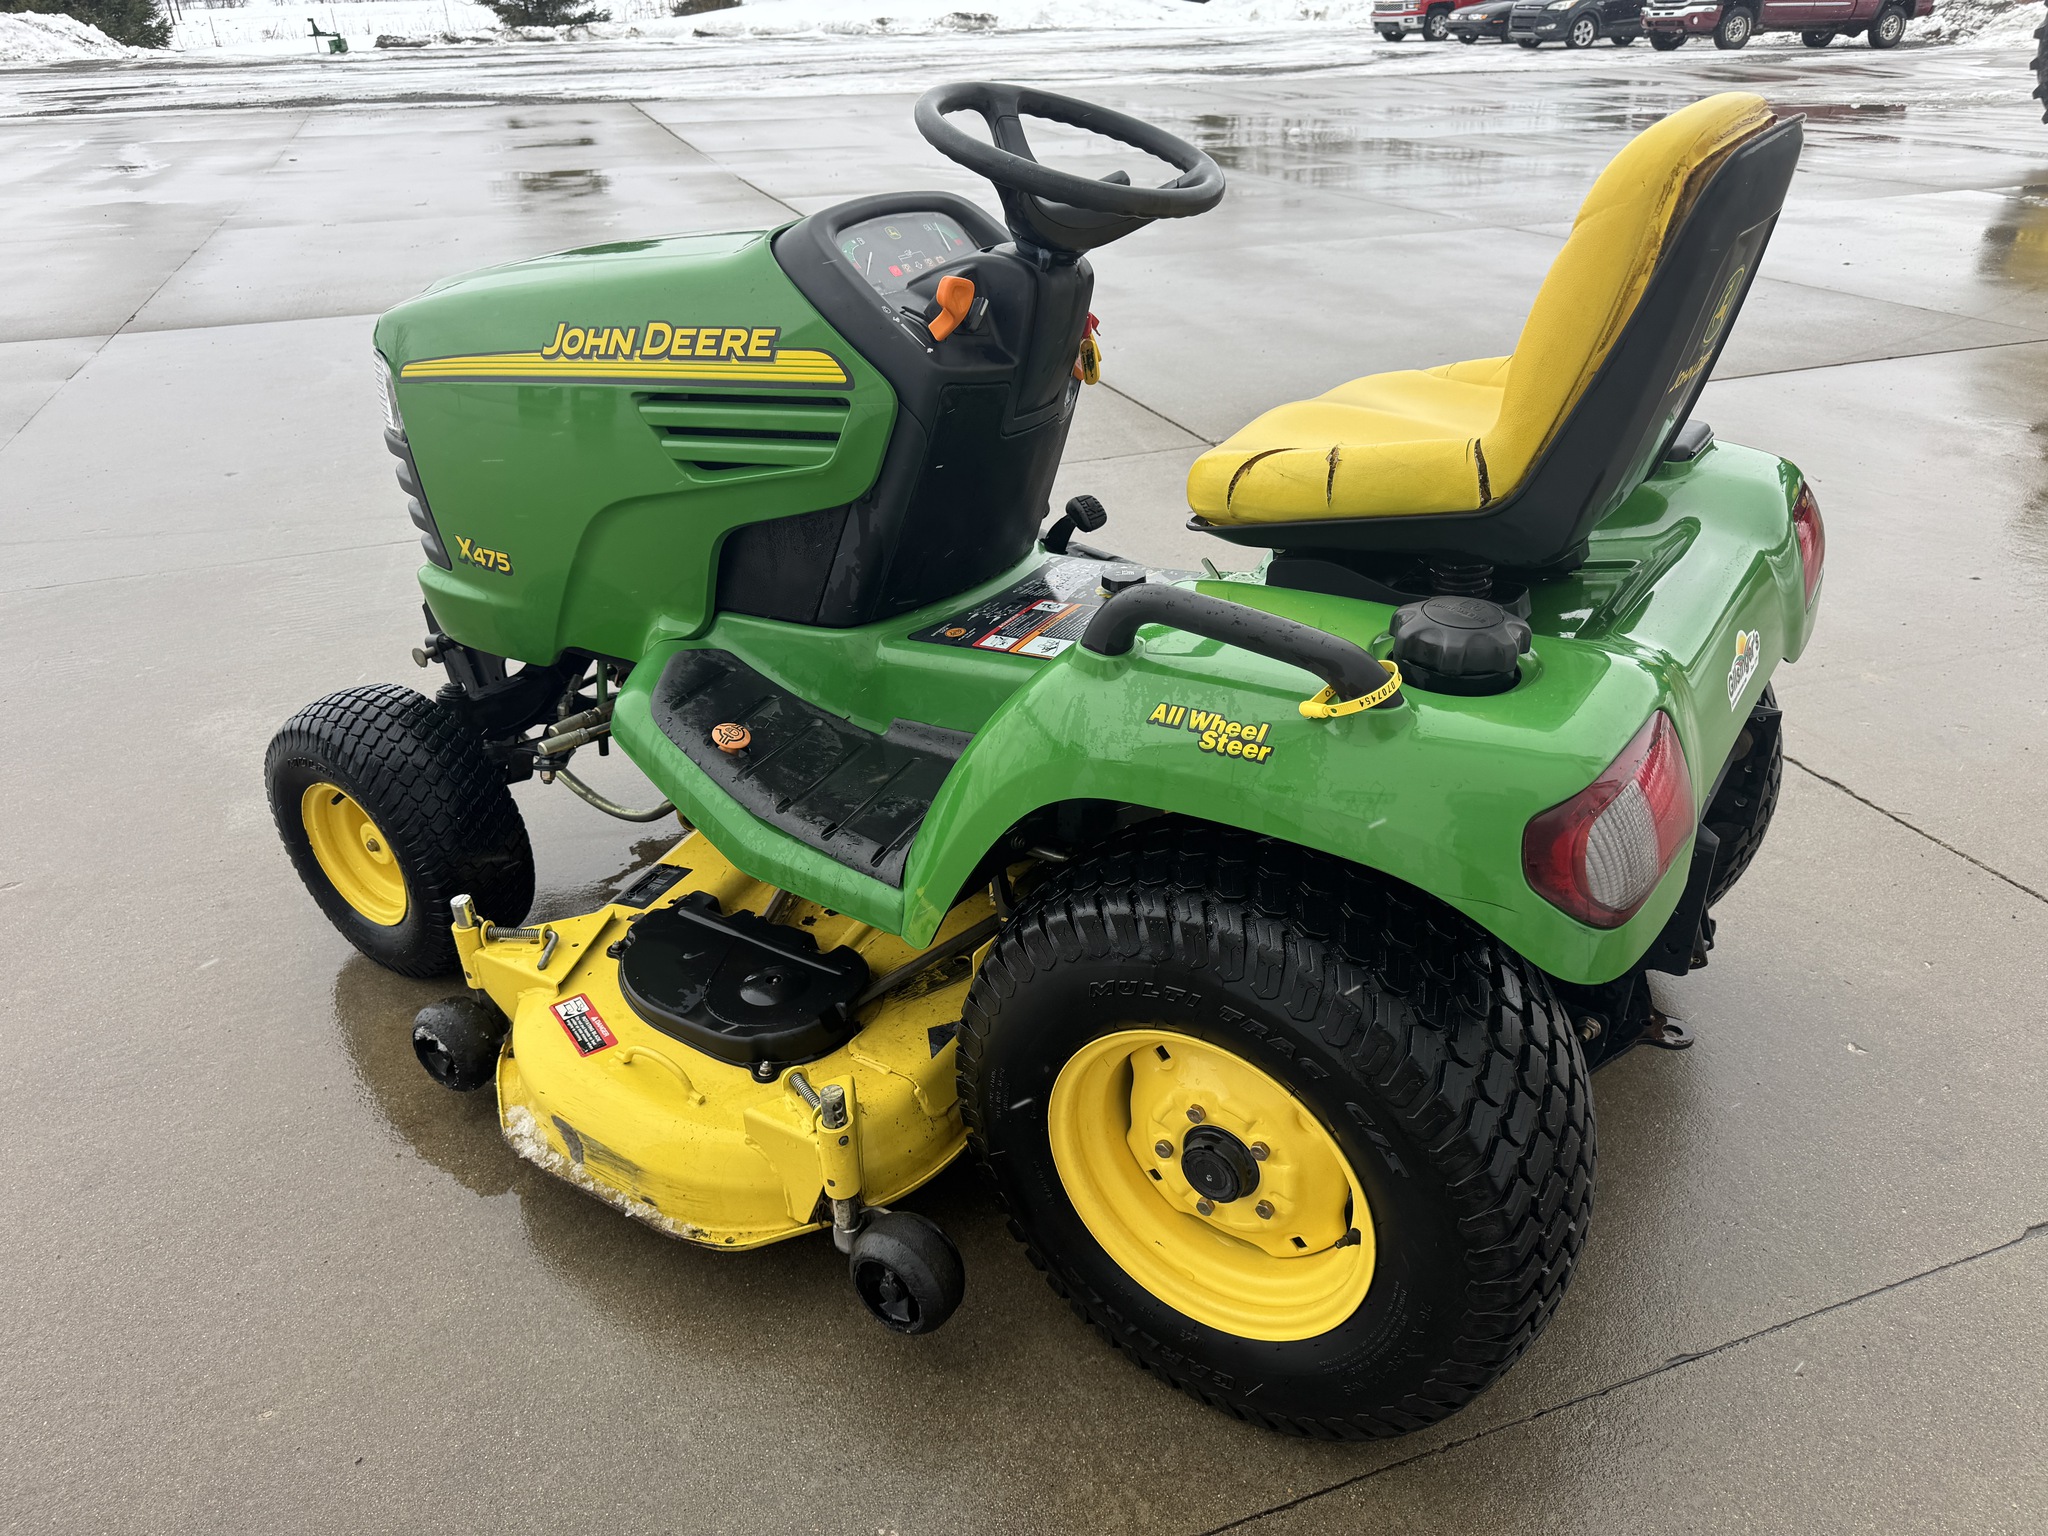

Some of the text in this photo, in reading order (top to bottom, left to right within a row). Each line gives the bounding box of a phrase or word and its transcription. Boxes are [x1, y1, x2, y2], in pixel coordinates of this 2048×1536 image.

[541, 321, 779, 360] JOHN DEERE
[454, 534, 513, 575] X475
[1148, 702, 1270, 744] All Wheel
[1198, 730, 1273, 764] Steer
[594, 1019, 610, 1037] DANGER
[1088, 979, 1203, 1008] MULTI
[1218, 1004, 1331, 1081] TRAC
